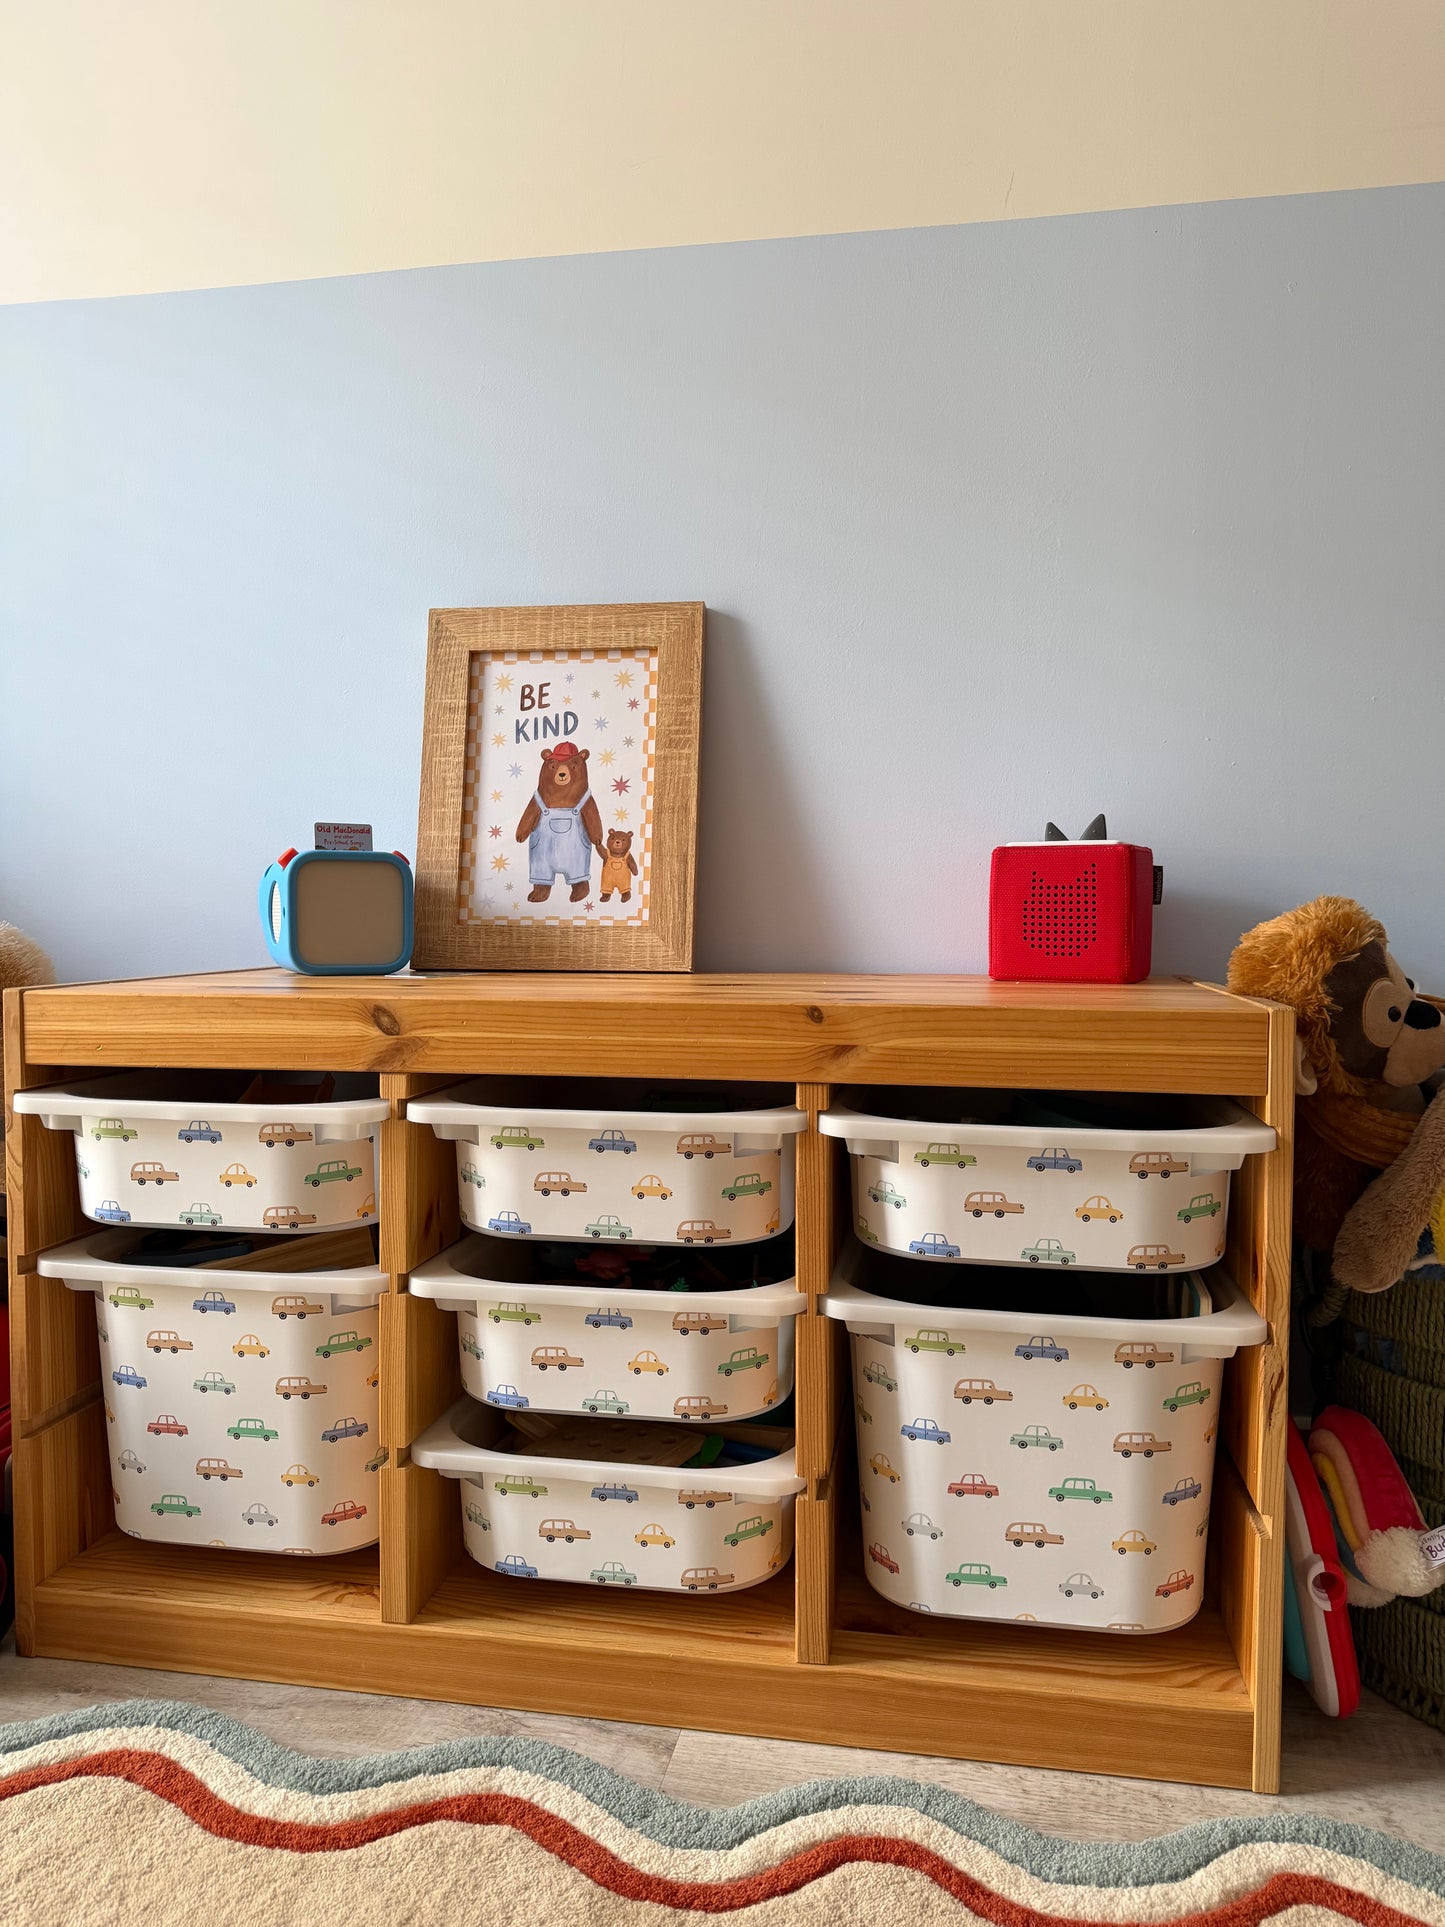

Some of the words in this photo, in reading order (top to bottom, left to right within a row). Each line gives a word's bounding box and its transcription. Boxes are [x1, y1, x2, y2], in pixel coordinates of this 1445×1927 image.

[520, 682, 551, 711] BE
[515, 711, 579, 744] KIND
[316, 825, 331, 833] Old
[333, 826, 371, 834] MacDonald
